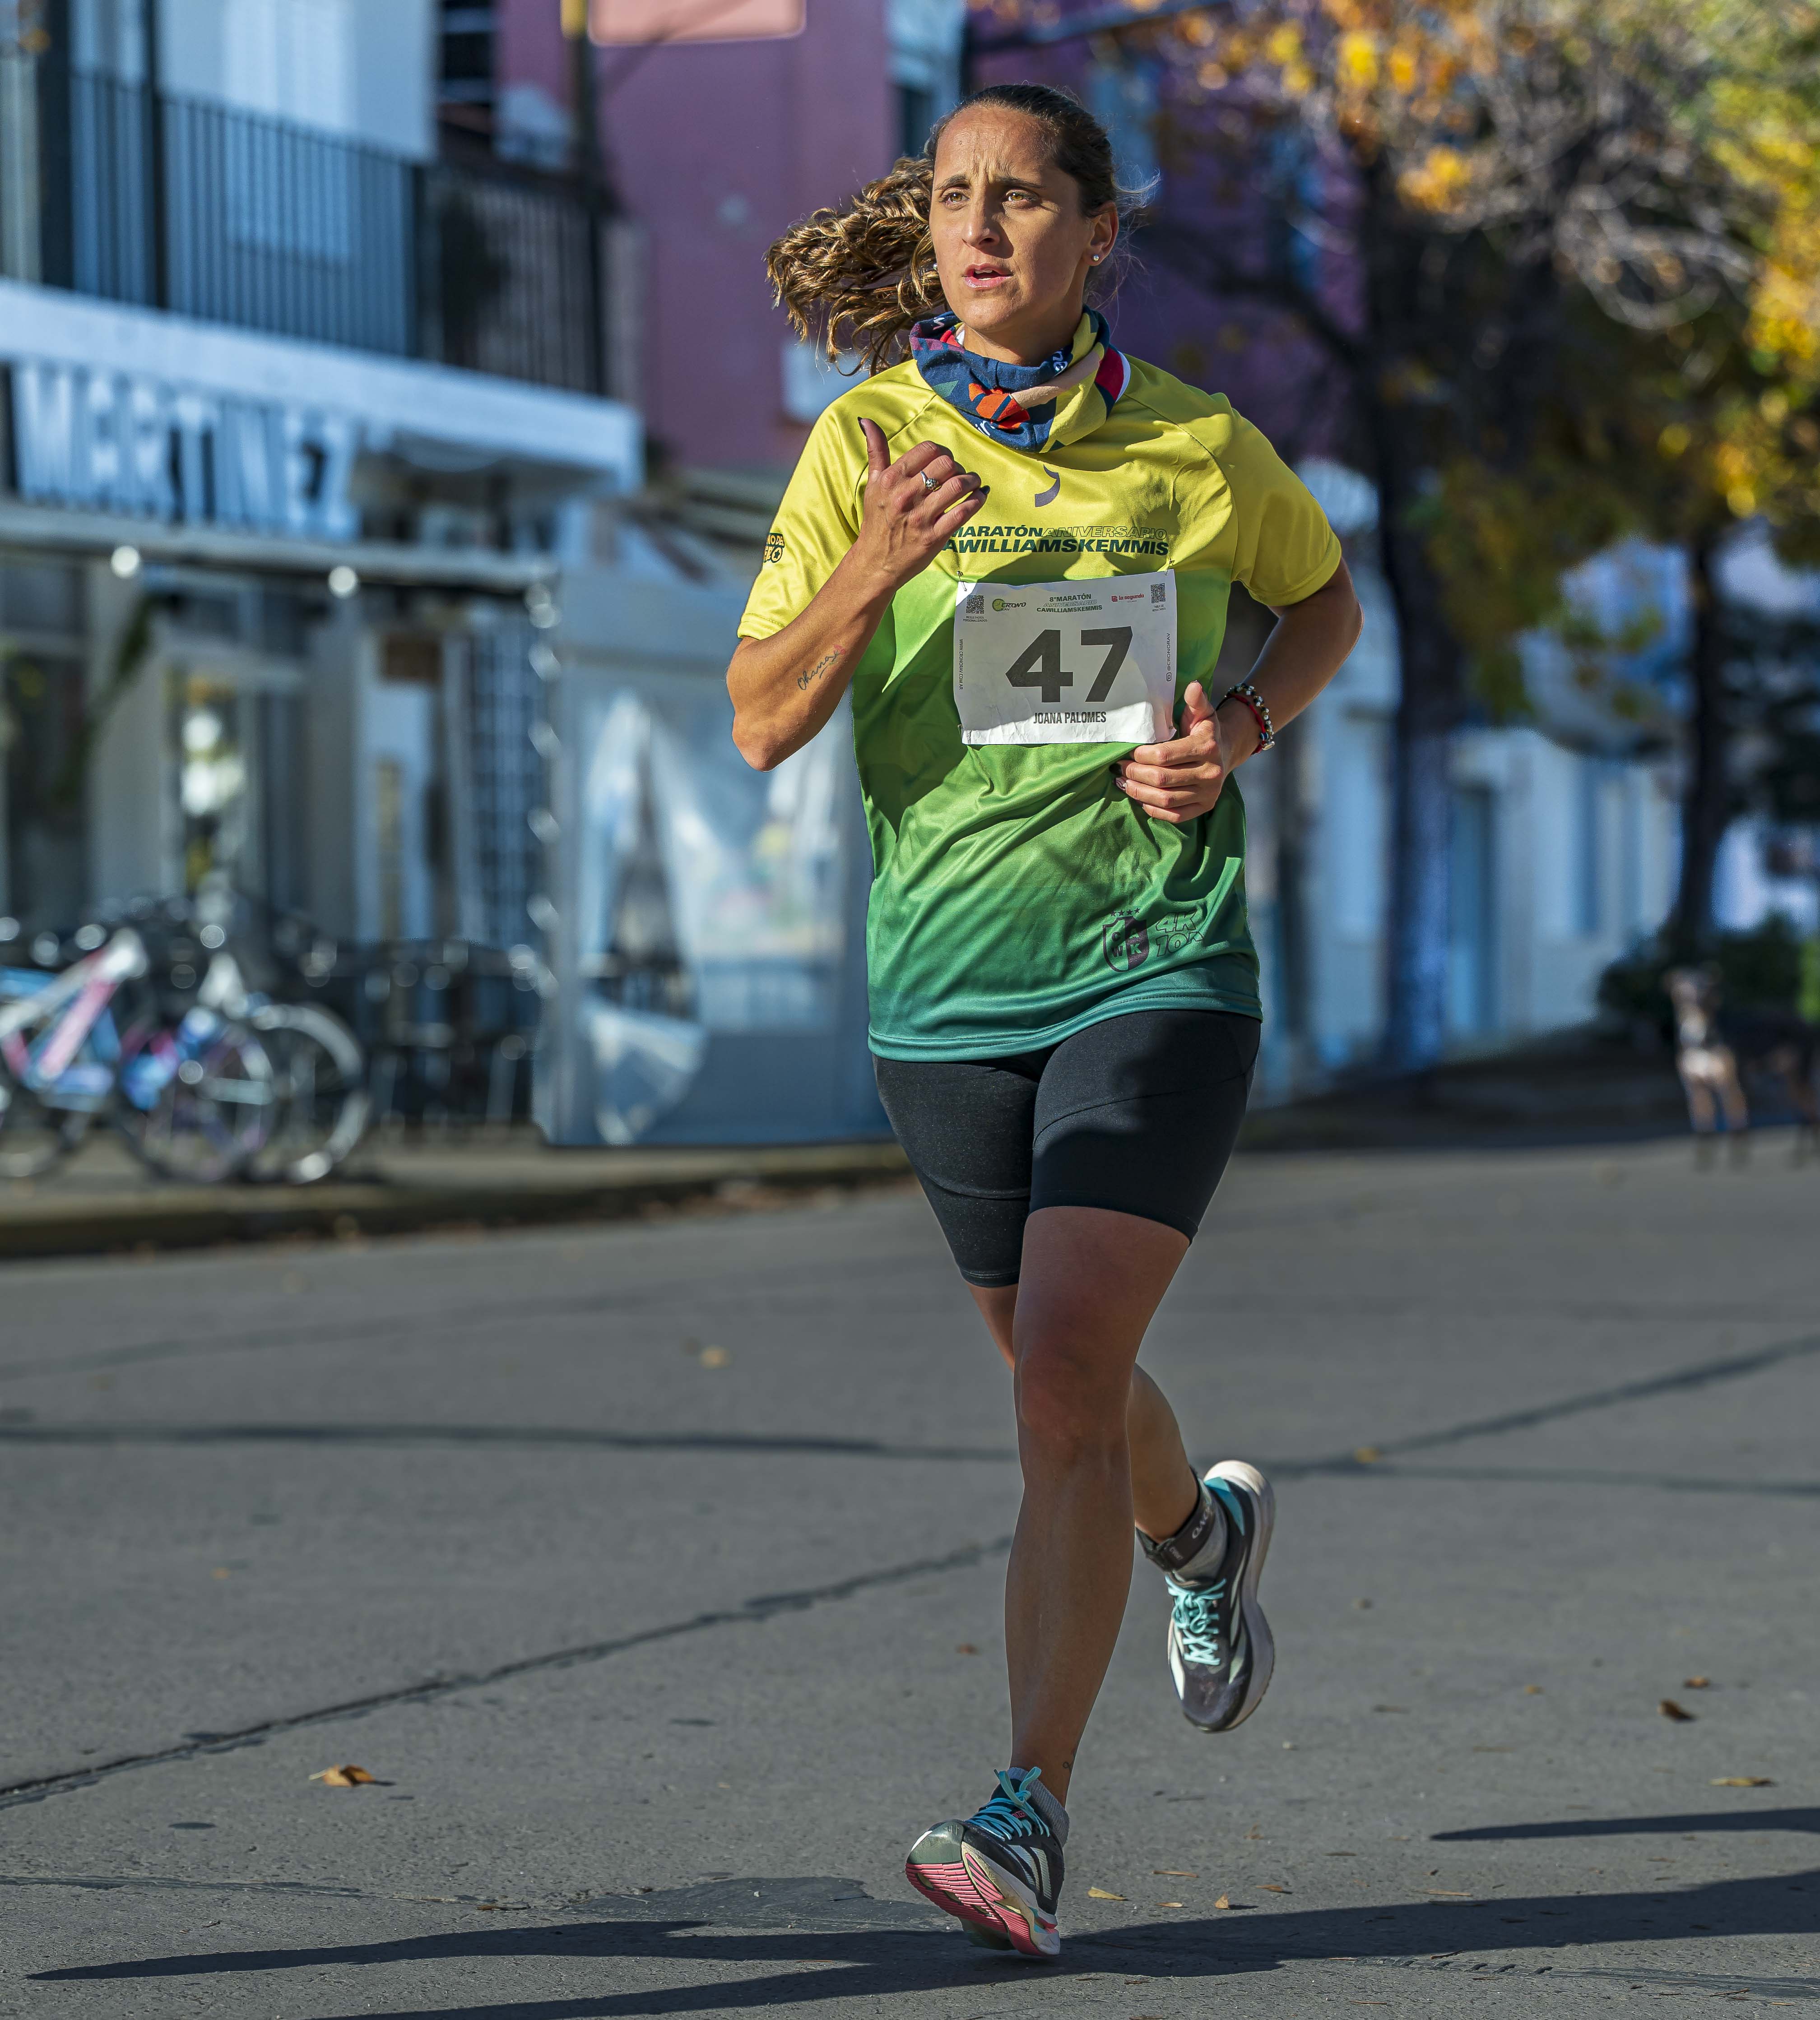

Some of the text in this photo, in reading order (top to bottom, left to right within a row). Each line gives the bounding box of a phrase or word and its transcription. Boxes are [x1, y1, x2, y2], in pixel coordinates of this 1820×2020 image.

[1036, 605, 1103, 613] CAWILLIAMSKEMMIS
[1005, 625, 1133, 703] 47
[1034, 711, 1106, 724] JOANA PALOMES
[1156, 909, 1197, 933] 4K
[1130, 943, 1142, 954] K
